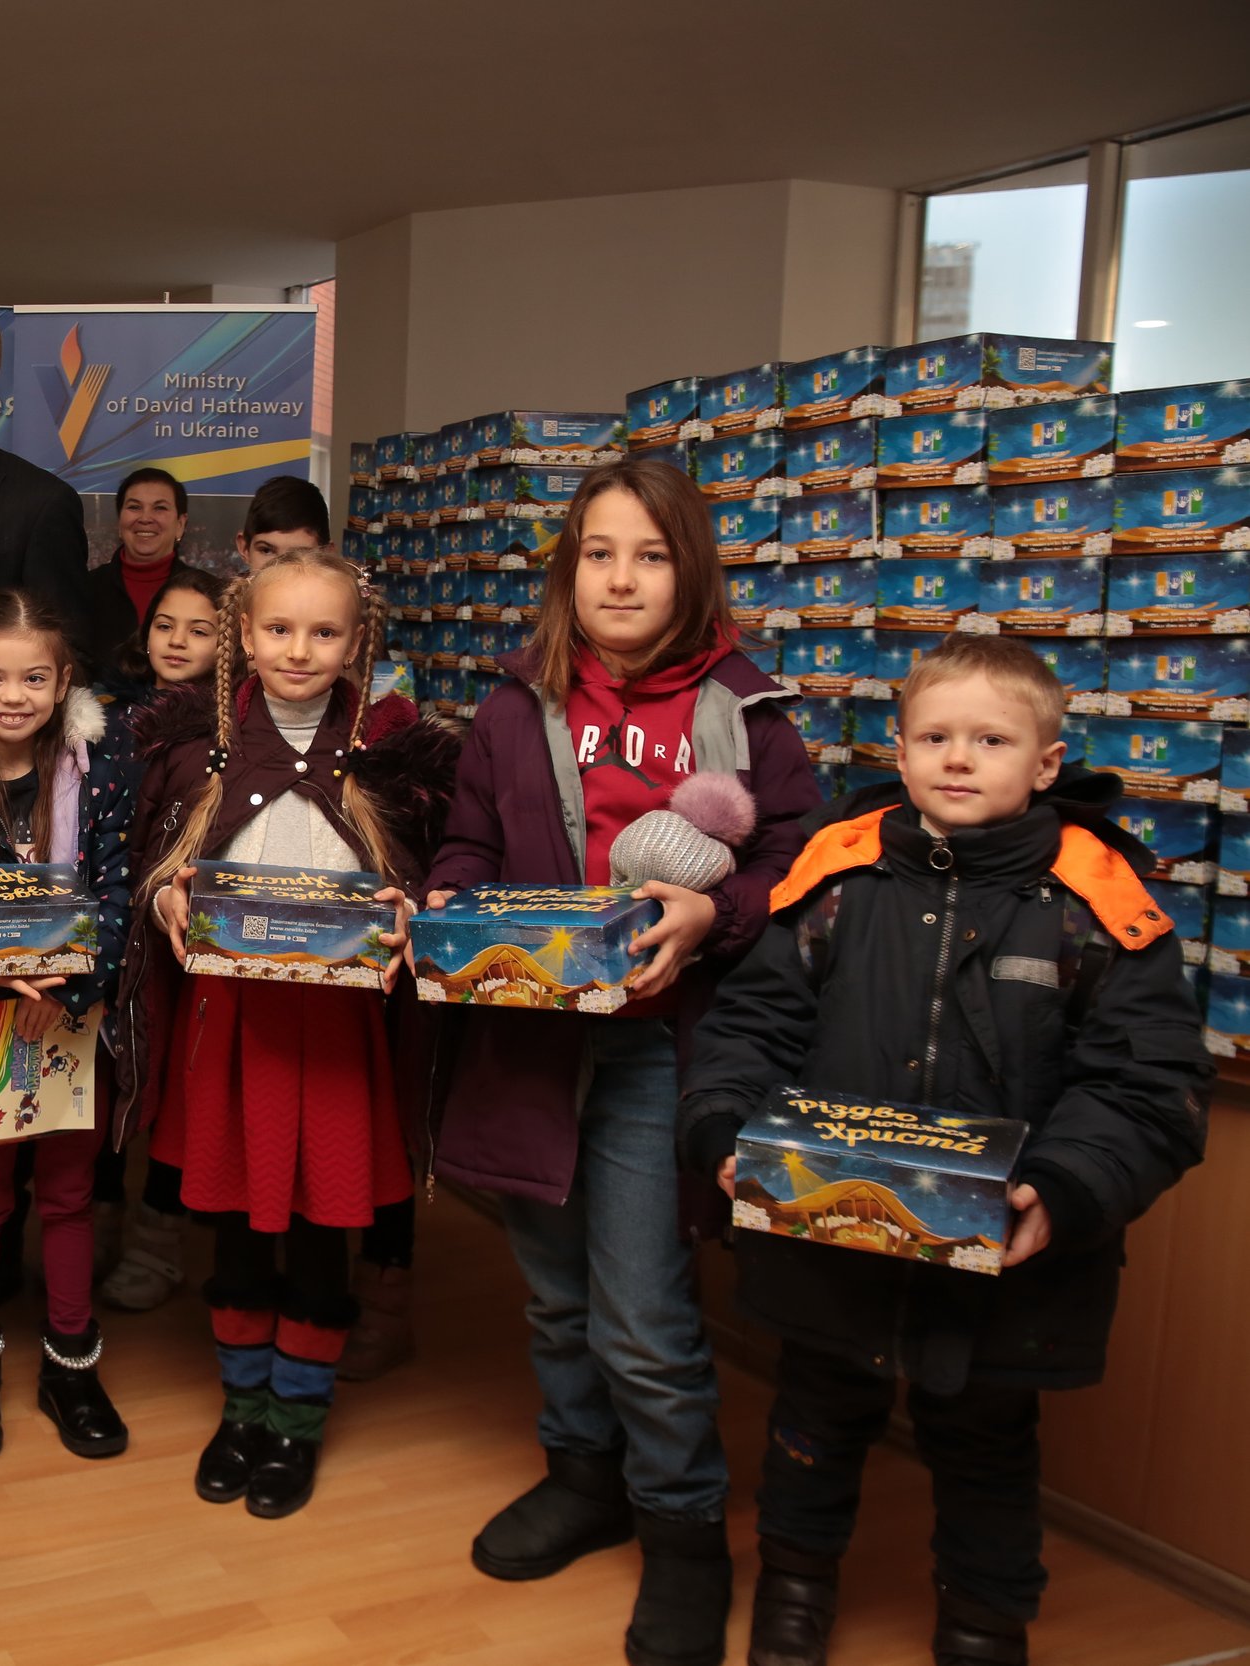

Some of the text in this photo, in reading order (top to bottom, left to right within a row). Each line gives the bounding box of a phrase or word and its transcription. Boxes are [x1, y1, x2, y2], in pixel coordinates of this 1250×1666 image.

[164, 373, 247, 391] Ministry
[106, 397, 304, 416] of David Hathaway
[155, 422, 260, 438] in Ukraine
[215, 872, 340, 889] Христа
[473, 888, 575, 900] Різдво
[476, 902, 611, 916] Христа
[787, 1099, 919, 1122] Різдво
[869, 1119, 970, 1138] почалося
[813, 1121, 986, 1155] Христа
